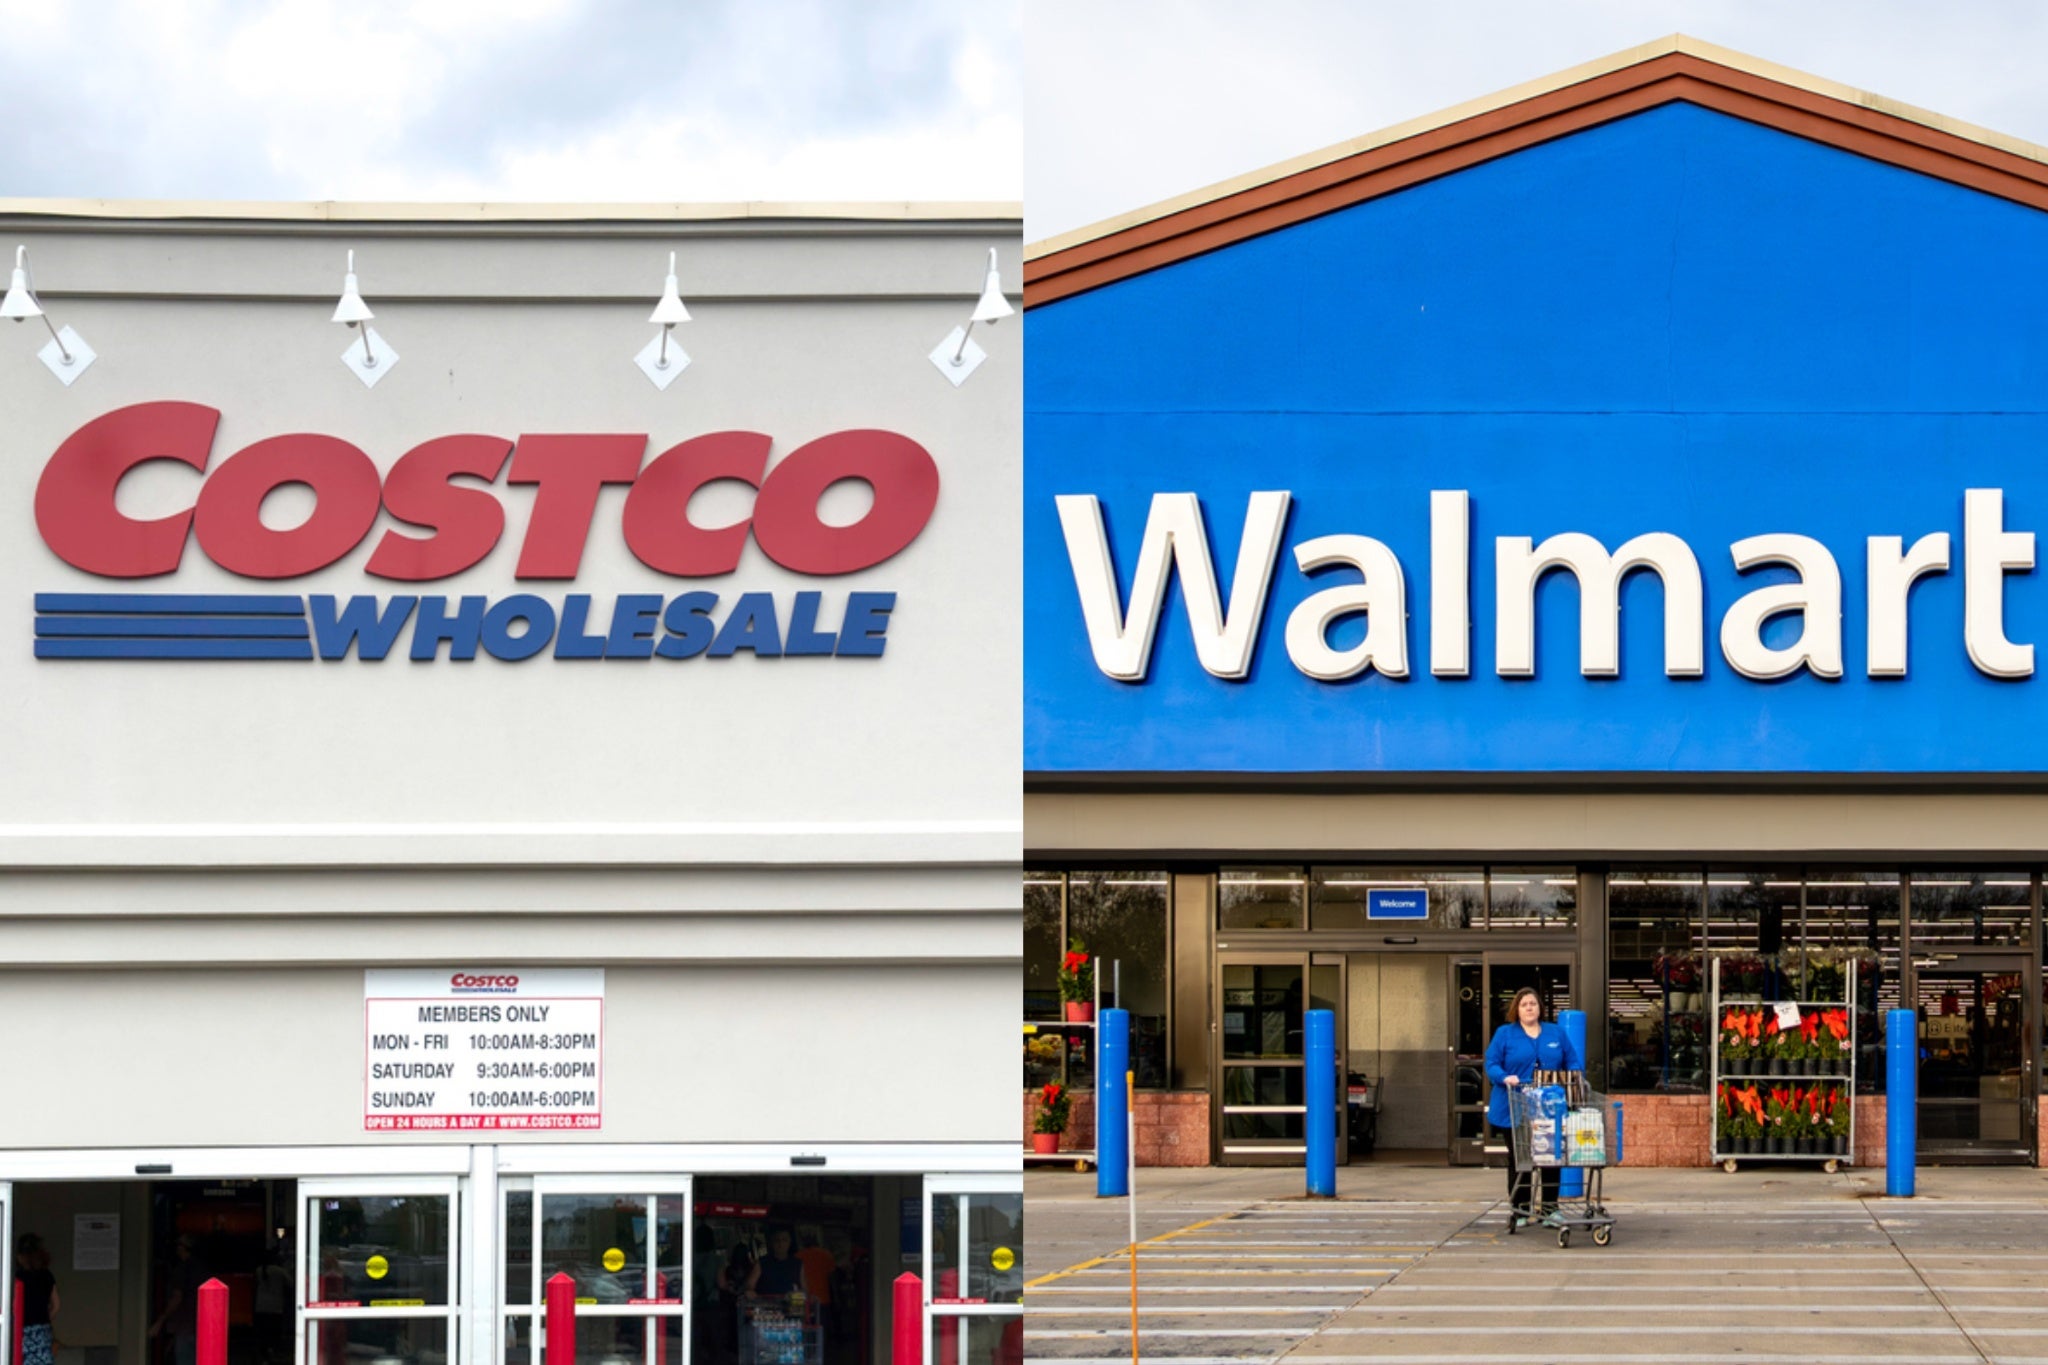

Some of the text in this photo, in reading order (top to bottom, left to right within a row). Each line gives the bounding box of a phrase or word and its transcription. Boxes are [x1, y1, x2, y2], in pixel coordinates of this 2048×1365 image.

[34, 400, 940, 581] COSTCO
[1054, 488, 2036, 680] Walmart
[308, 591, 897, 661] WHOLESALE
[1379, 899, 1416, 908] Welcome
[451, 973, 519, 987] COSTCO
[418, 1005, 549, 1022] MEMBERS ONLY
[373, 1034, 409, 1050] MON
[424, 1034, 449, 1049] FRI
[469, 1033, 596, 1050] 10:00AM-8:30PM
[372, 1062, 595, 1079] SATURDAY 9:30AM-6:00PM
[372, 1090, 595, 1108] SUNDAY 10:00AM-6:00PM
[367, 1115, 599, 1129] OPEN 24 HOURS A DAY AT WWW.COSTCO.COM
